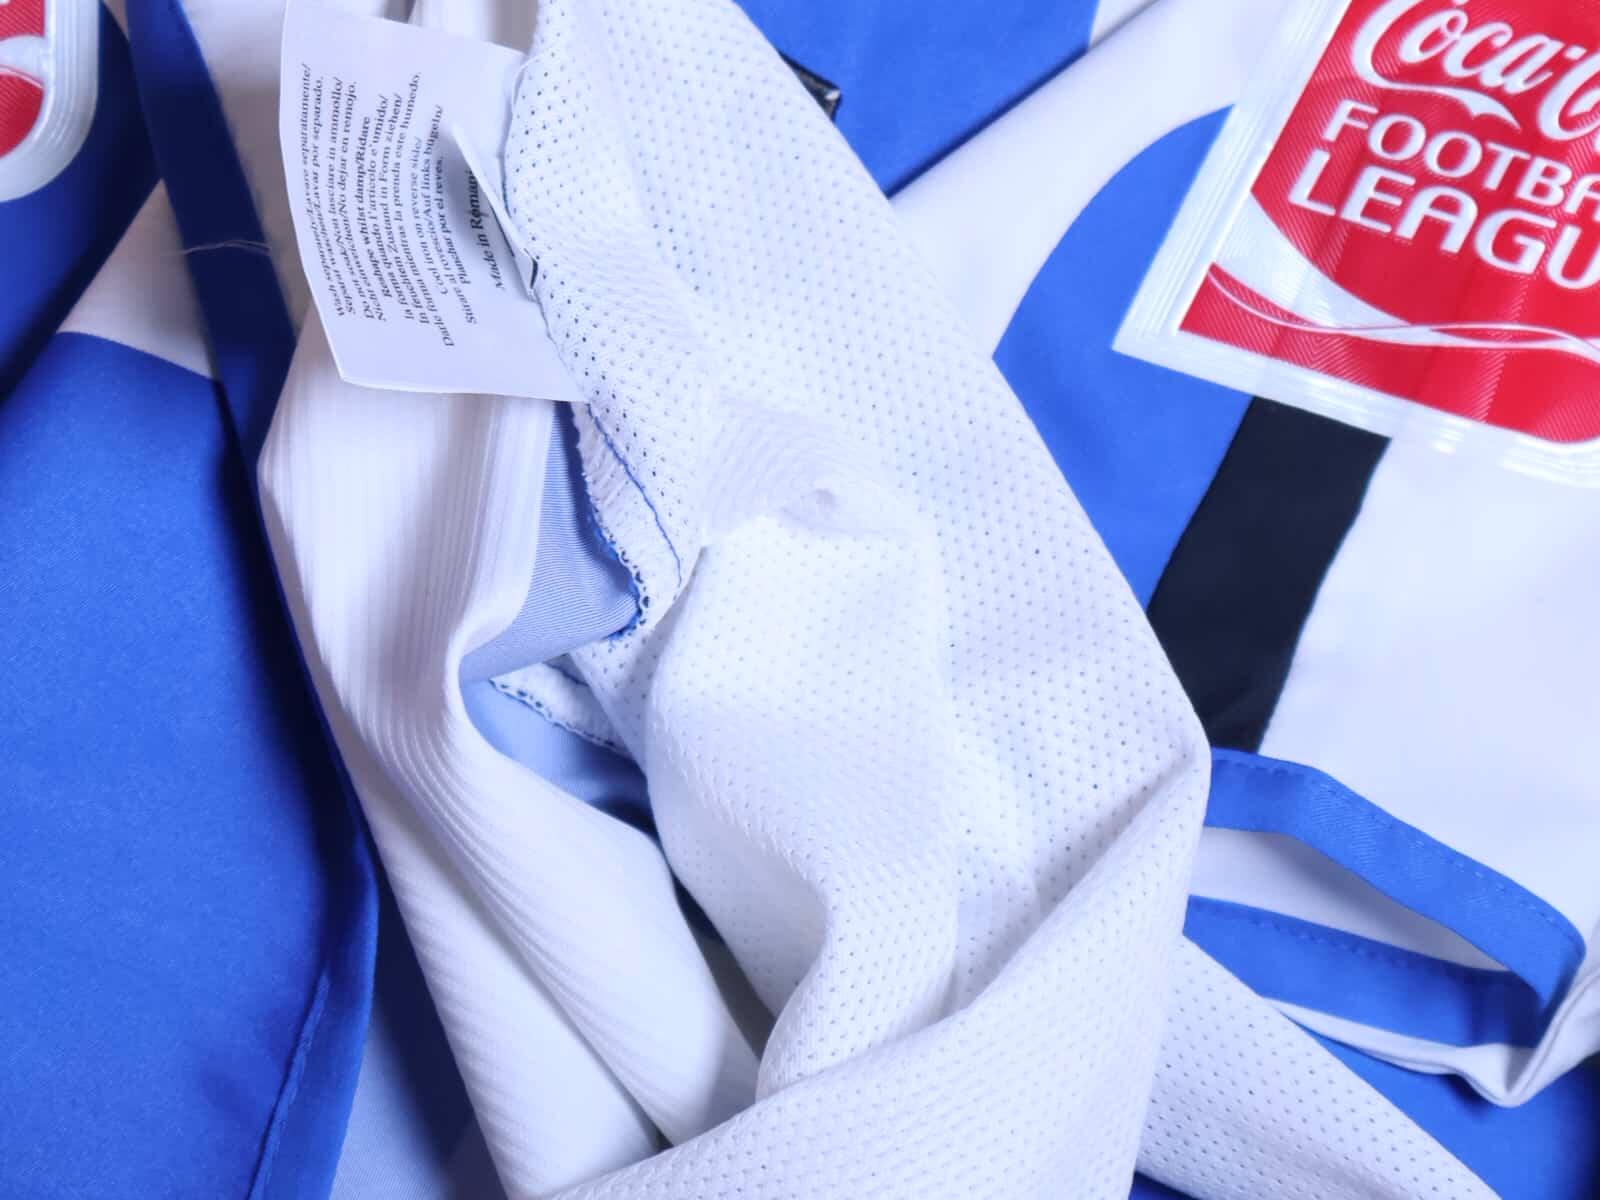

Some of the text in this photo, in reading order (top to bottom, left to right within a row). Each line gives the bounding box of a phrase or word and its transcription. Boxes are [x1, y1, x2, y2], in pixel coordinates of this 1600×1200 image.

[300, 63, 311, 166] separatamente/
[312, 76, 324, 140] separado.
[311, 144, 320, 168] por
[420, 158, 431, 190] links
[326, 76, 375, 319] Do not soak/Non lasciare in ammollo/
[336, 80, 386, 321] Nicht einweichen/No dejar en remojo.
[354, 116, 392, 298] Reshape whilst damp/Ridare
[378, 93, 430, 324] In feuchtem Zustand in Form ziehen/
[391, 71, 454, 348] Darle forma mientras la prenda este humedo.
[410, 136, 448, 295] Cool iron on reverse side/
[434, 198, 444, 209] el
[1288, 147, 1600, 289] LEAGU
[421, 192, 451, 270] rovescio/Auf
[437, 212, 452, 234] por
[476, 234, 490, 248] in
[370, 224, 391, 269] quando
[443, 238, 471, 284] Planchar
[334, 270, 354, 313] Separat
[386, 272, 408, 306] forma
[444, 273, 456, 284] al
[482, 251, 507, 290] Made
[328, 284, 346, 316] Wash
[400, 308, 415, 320] la
[452, 287, 478, 324] Stirare
